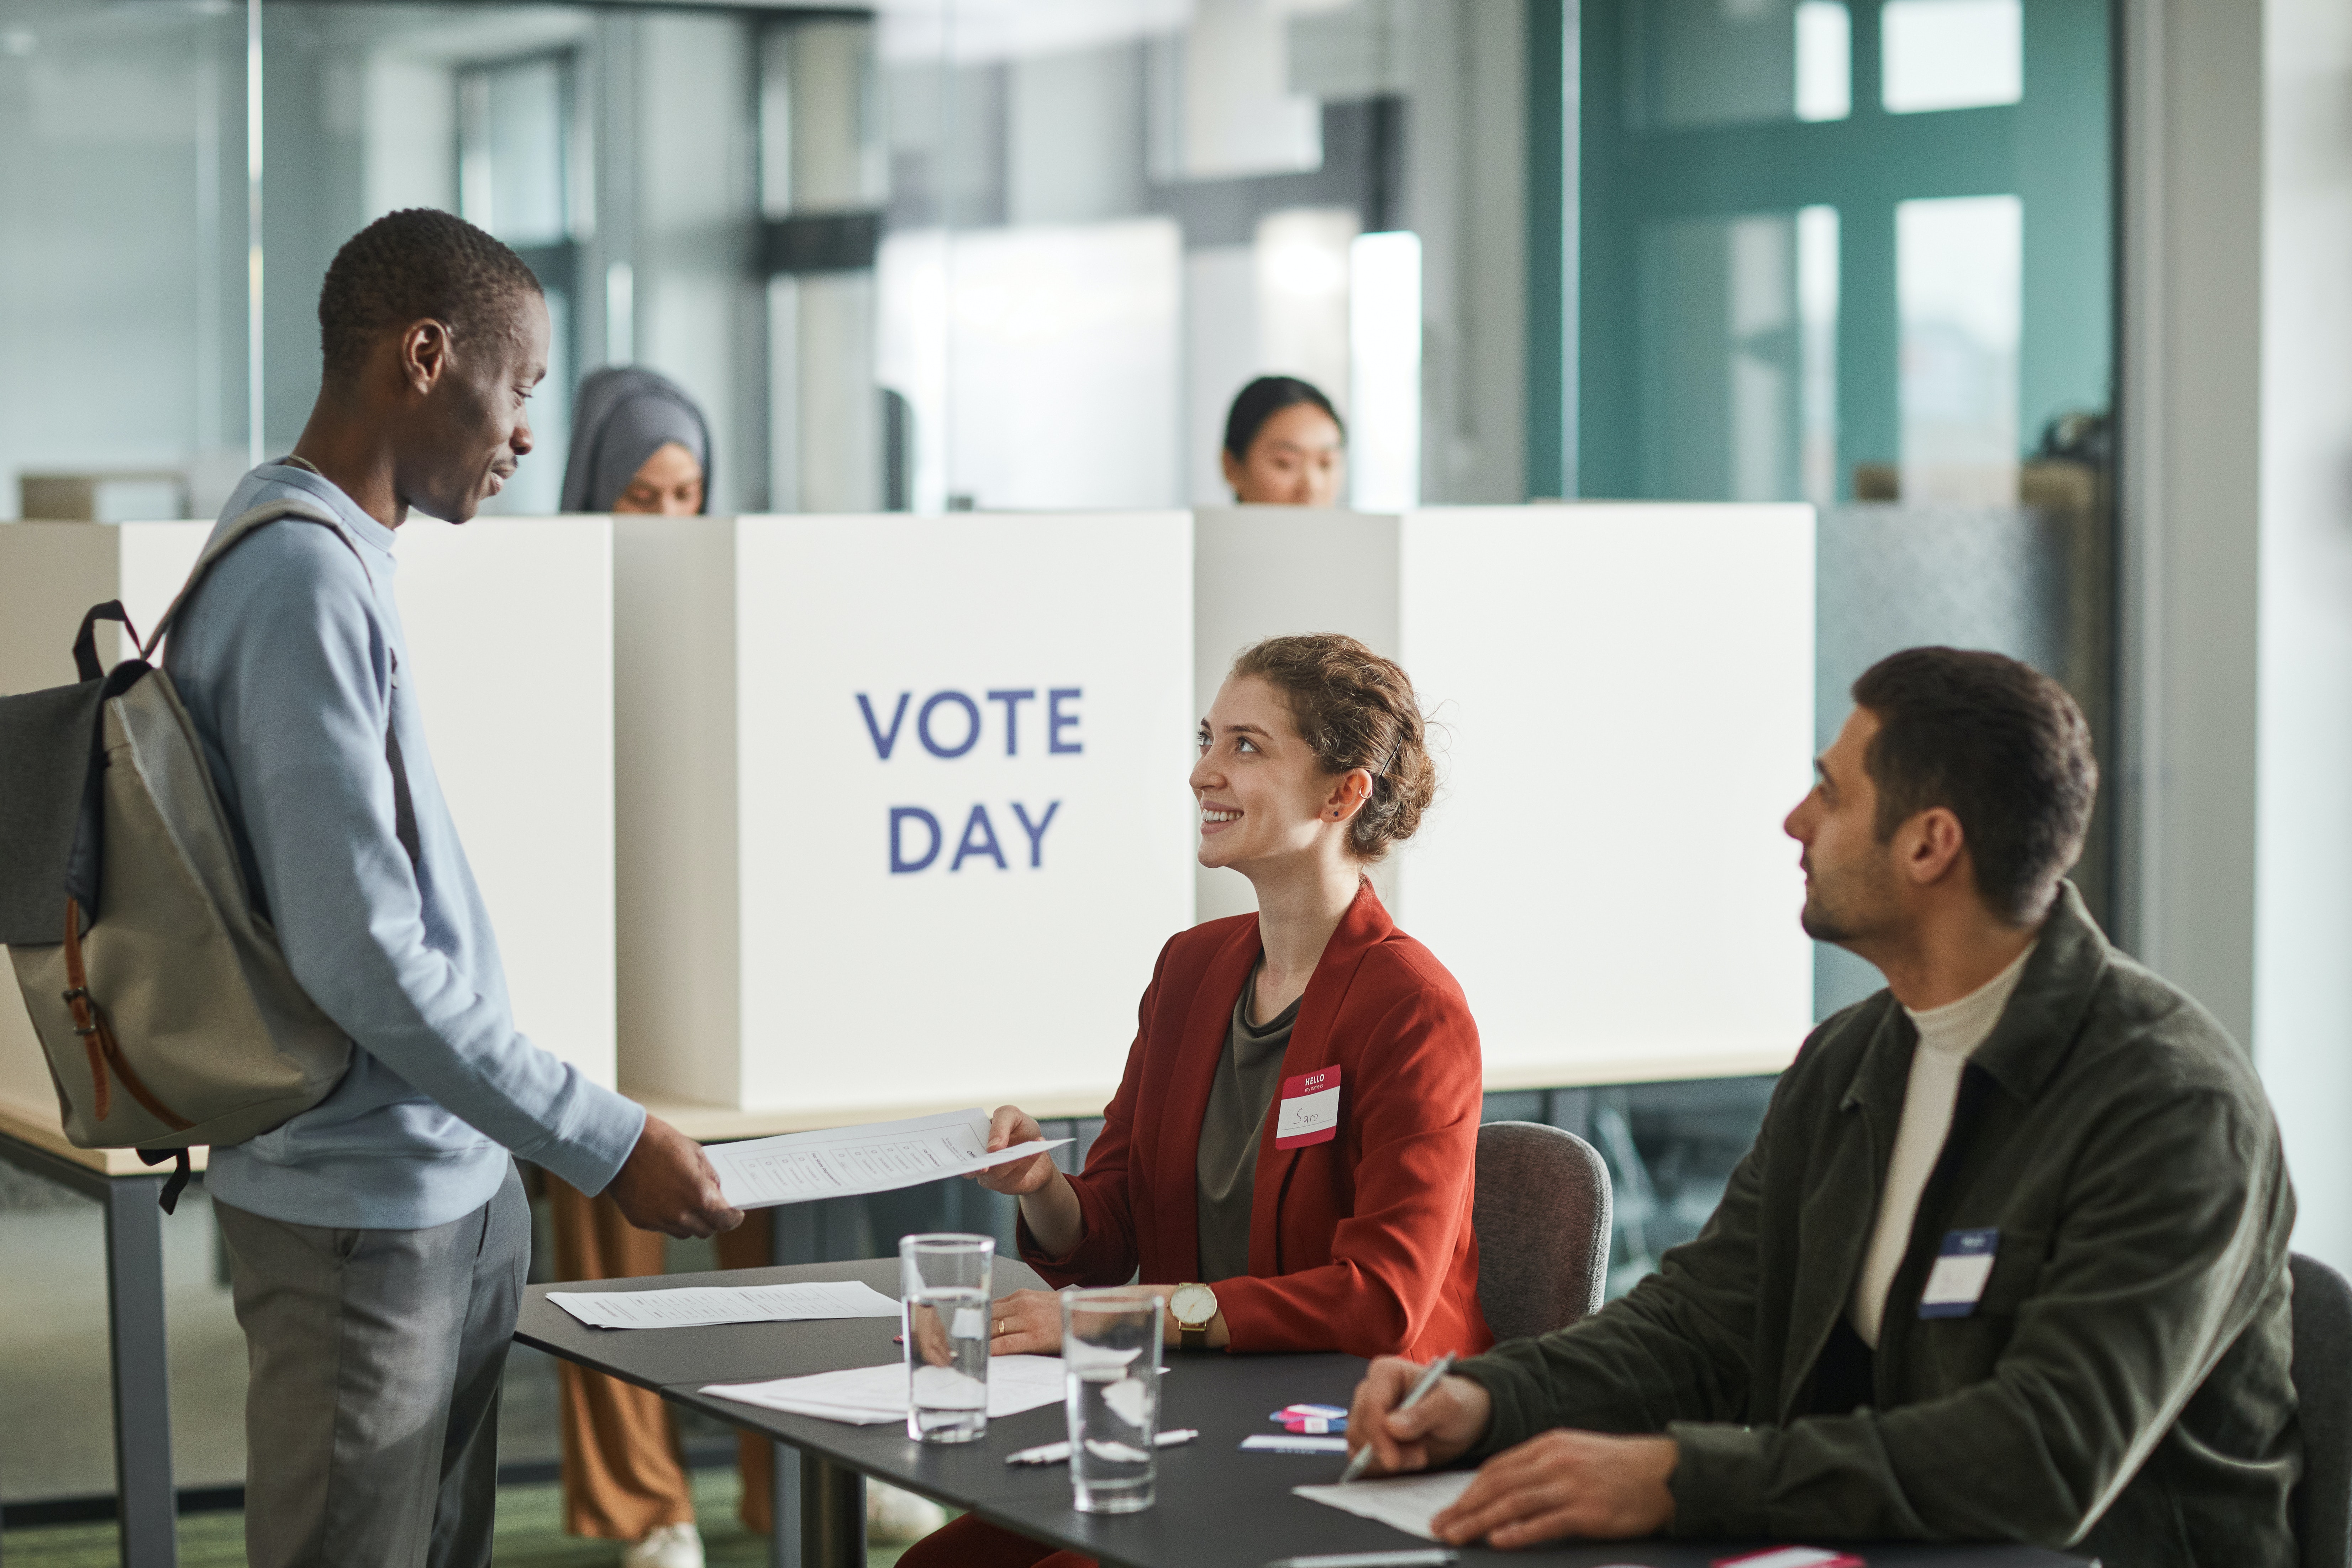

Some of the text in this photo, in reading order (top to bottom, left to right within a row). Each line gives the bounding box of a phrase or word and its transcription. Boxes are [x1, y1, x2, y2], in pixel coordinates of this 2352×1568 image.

[856, 688, 1083, 759] VOTE
[890, 801, 1060, 874] DAY
[1305, 1074, 1324, 1086] HELLO
[1294, 1108, 1318, 1124] Sara
